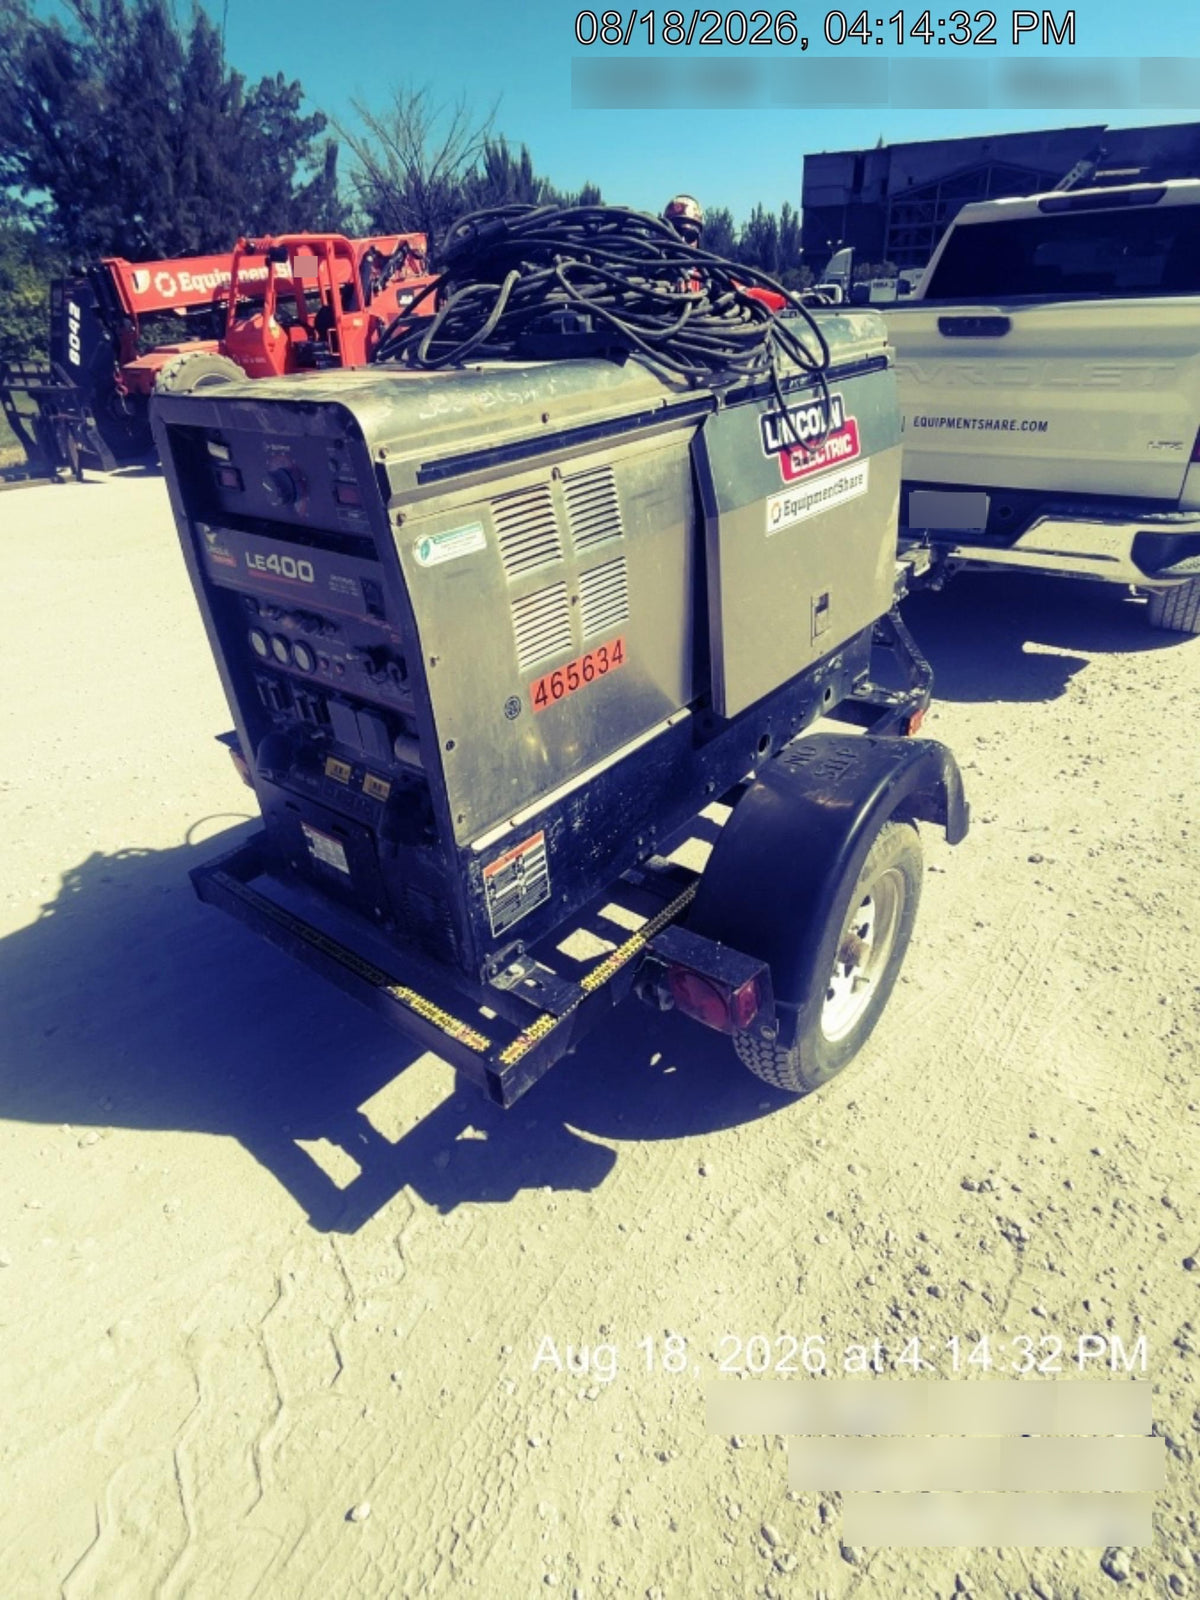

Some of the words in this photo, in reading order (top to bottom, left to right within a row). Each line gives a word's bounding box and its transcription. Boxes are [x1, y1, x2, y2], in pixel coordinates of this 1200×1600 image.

[68, 301, 81, 366] 8042
[764, 400, 842, 450] LINCOLN
[913, 415, 1049, 433] EQUIPMENTSHARE.COM
[790, 433, 853, 473] ELECTRIC
[783, 473, 864, 518] EquipmentShare
[245, 551, 315, 583] LE400
[534, 639, 624, 706] 465634
